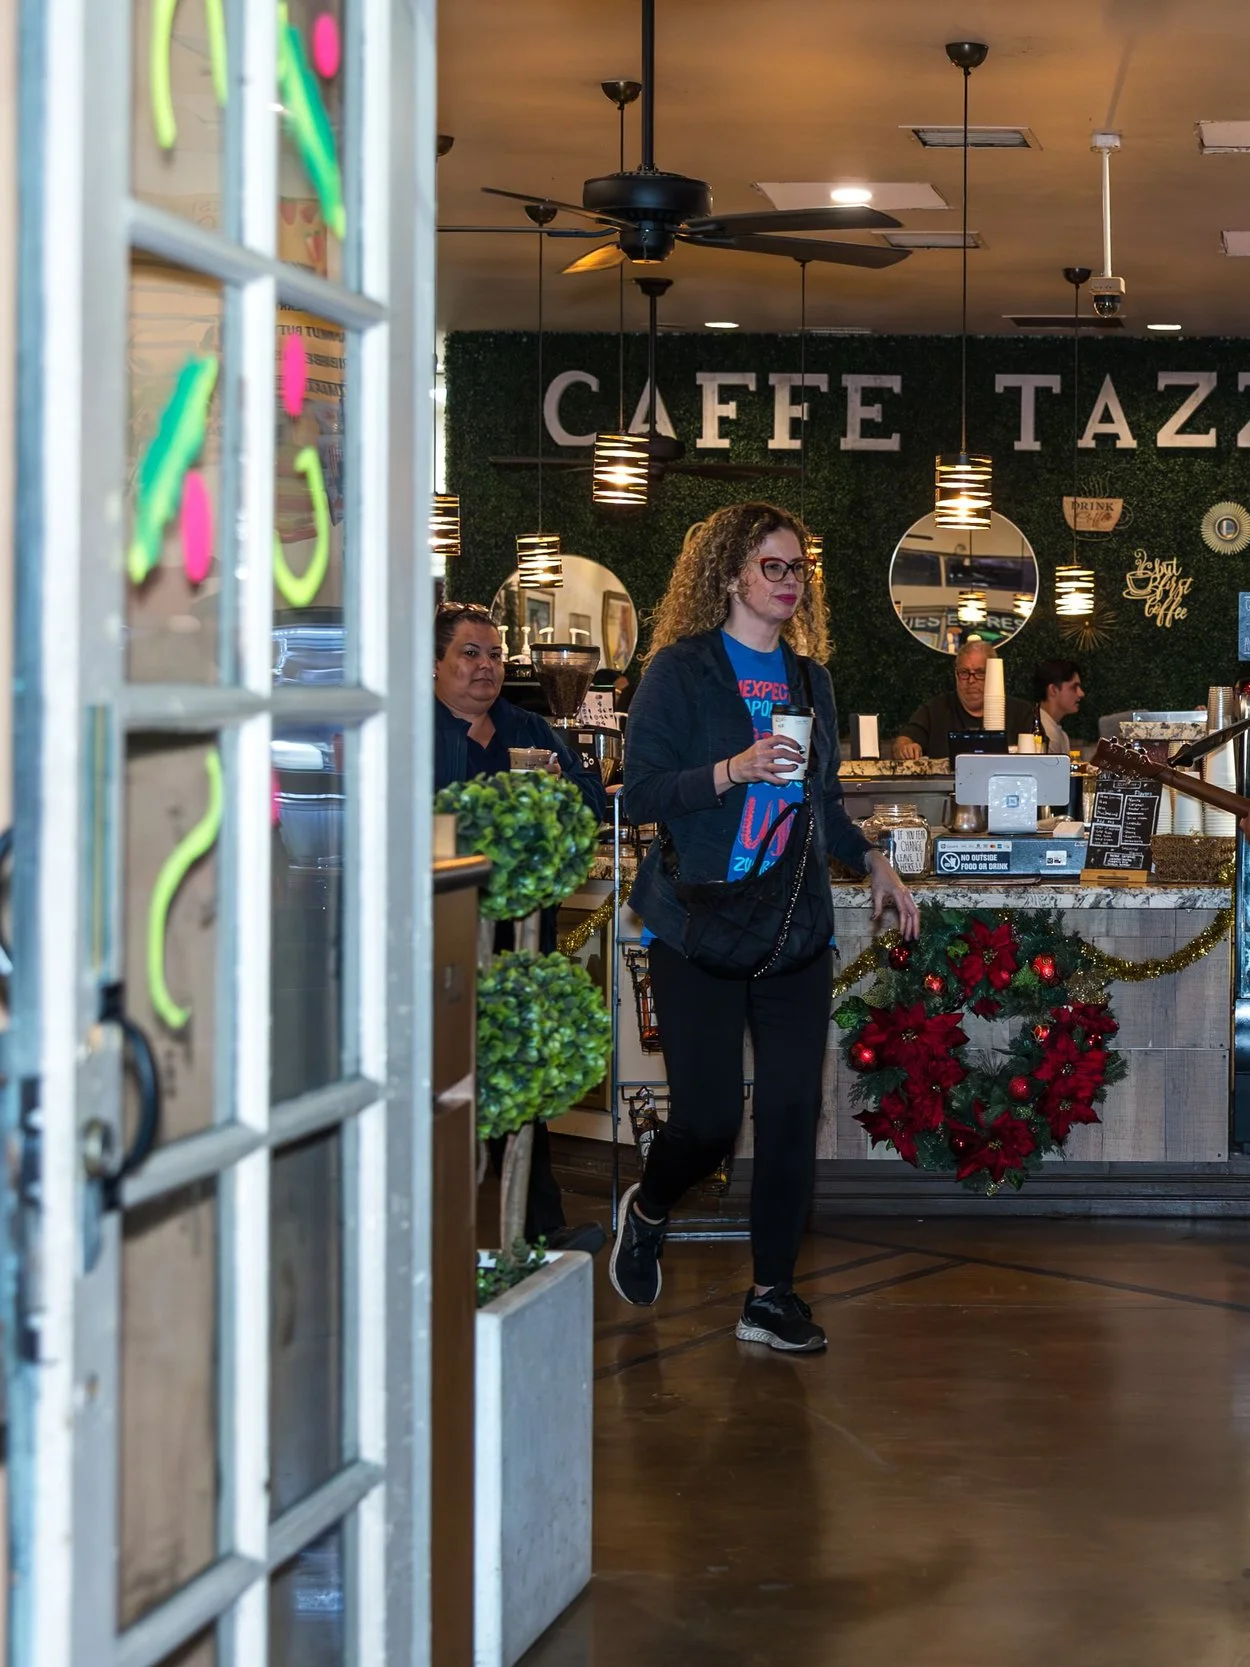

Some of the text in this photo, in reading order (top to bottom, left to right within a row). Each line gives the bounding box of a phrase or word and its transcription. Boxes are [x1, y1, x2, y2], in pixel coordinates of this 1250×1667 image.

[543, 370, 901, 450] CAFFE
[1071, 501, 1114, 511] DRINK
[961, 854, 998, 862] NO OUTSIDE
